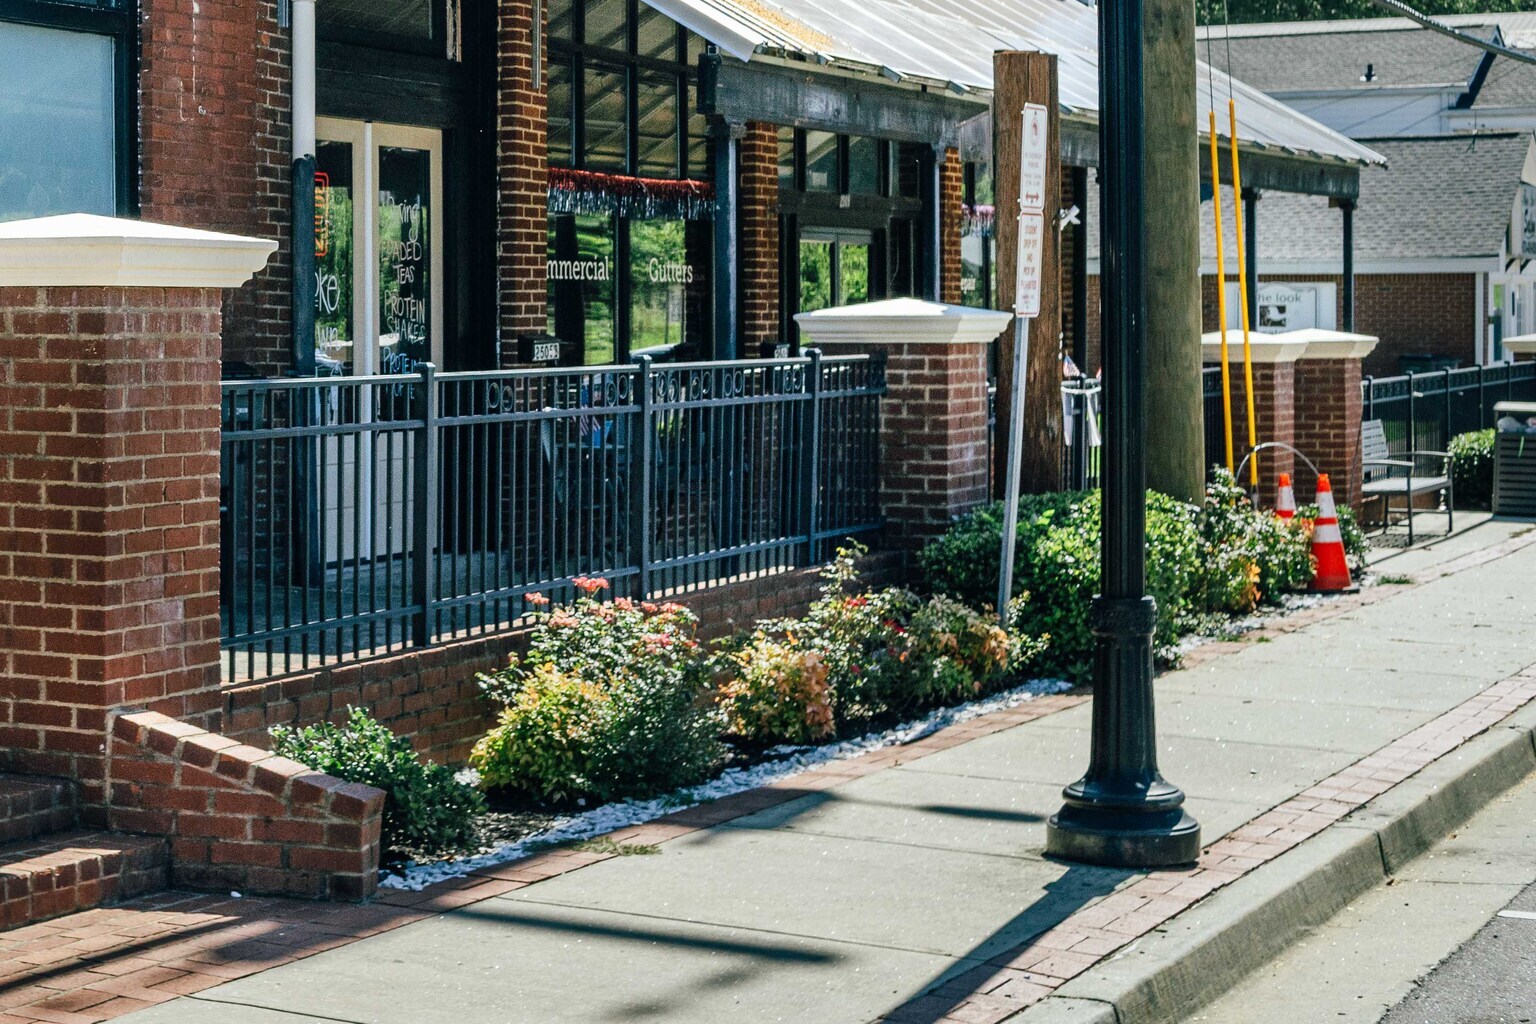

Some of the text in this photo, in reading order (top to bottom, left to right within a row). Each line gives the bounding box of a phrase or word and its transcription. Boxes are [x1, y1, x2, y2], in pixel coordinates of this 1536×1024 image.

[392, 264, 415, 285] TEAS
[546, 256, 694, 284] mmercial Gutters
[384, 289, 425, 324] PROTEIN
[386, 316, 426, 345] SHAKES
